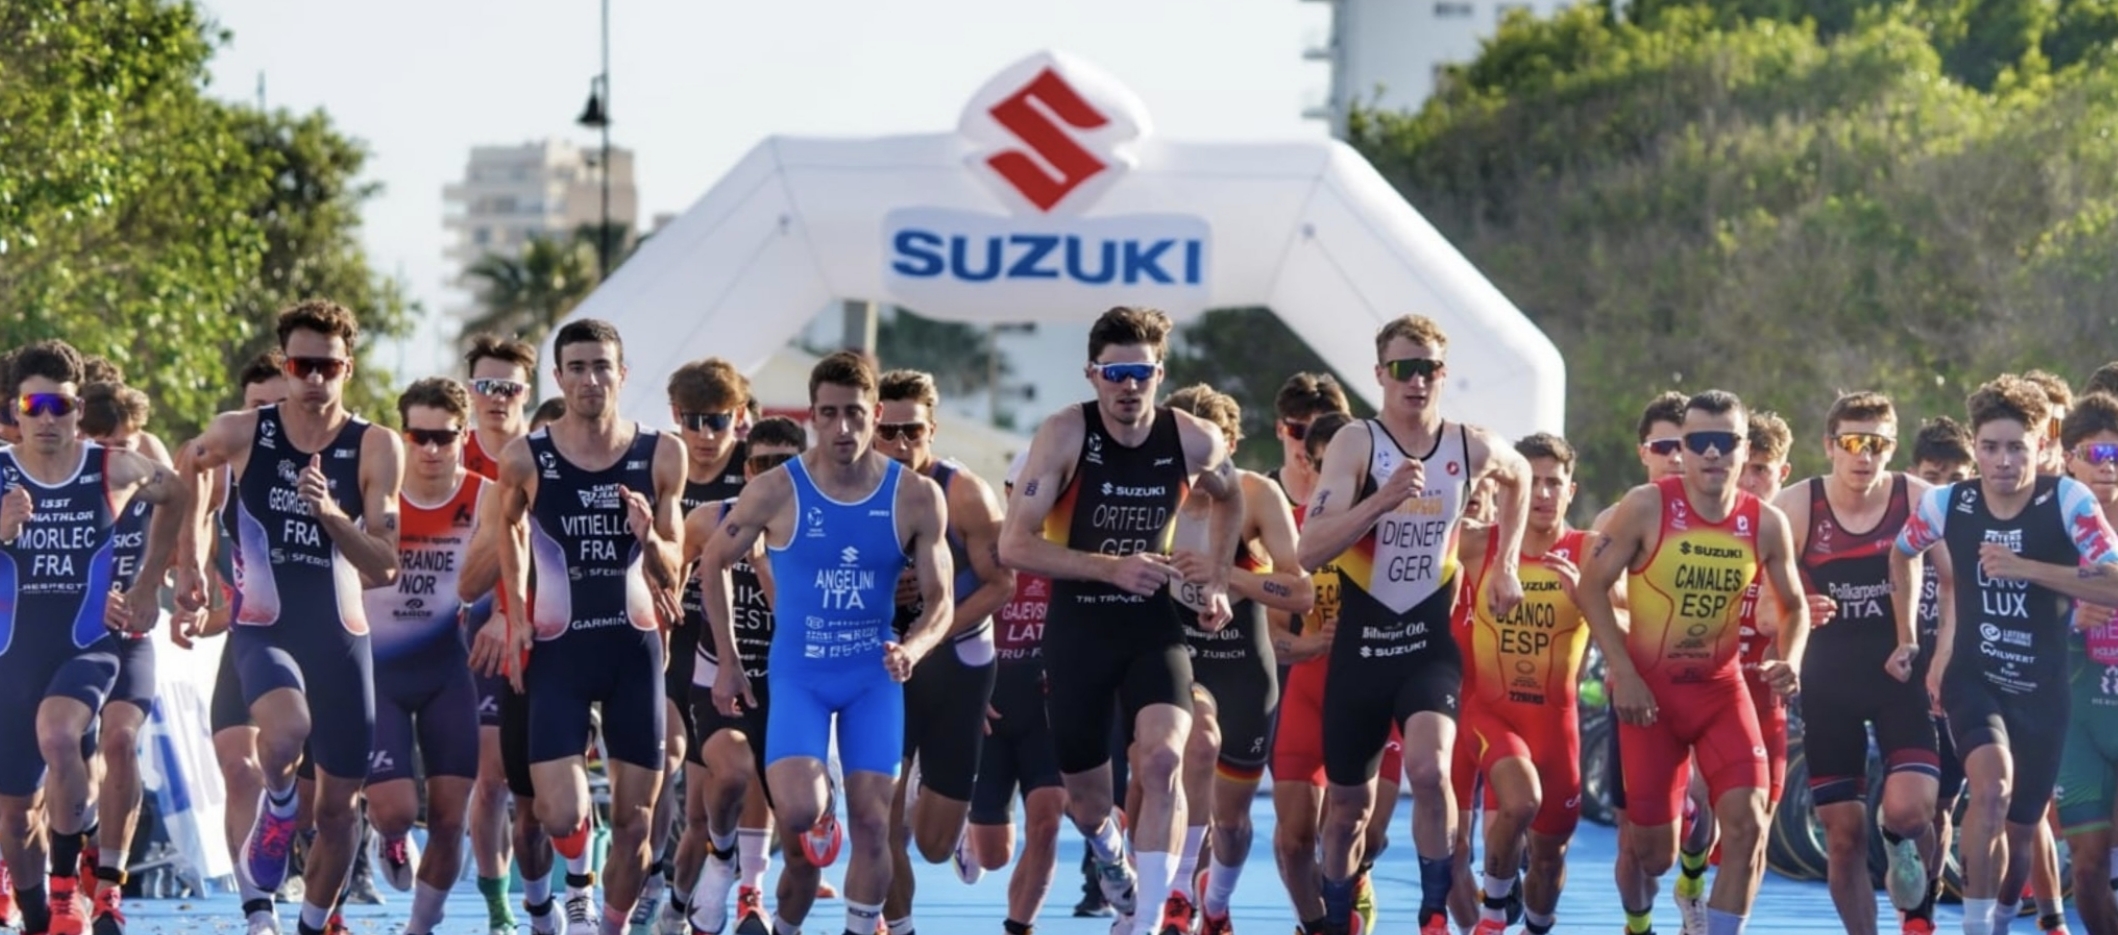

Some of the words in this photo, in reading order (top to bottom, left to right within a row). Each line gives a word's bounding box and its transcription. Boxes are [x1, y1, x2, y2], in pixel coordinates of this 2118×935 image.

[891, 229, 1202, 285] SUZUKI
[592, 483, 619, 492] SAINT
[1115, 486, 1166, 497] SUZUKI
[561, 514, 633, 537] VITIELLO
[1093, 504, 1166, 531] ORTFELD
[17, 526, 96, 550] MORLEC
[112, 532, 143, 548] SICS
[284, 519, 321, 548] FRA
[1382, 521, 1446, 548] DIENER
[399, 549, 455, 572] RANDE
[580, 540, 617, 561] FRA
[1694, 545, 1743, 559] SUZUKI
[32, 554, 75, 577] FRA
[1388, 554, 1433, 583] GER
[398, 573, 437, 595] NOR
[814, 568, 876, 591] ANGELINI
[1520, 581, 1563, 591] UZUKI
[1675, 563, 1742, 592] CANALES
[822, 588, 866, 611] ITA
[1075, 594, 1096, 604] TRI
[1098, 593, 1147, 604] TRAVEL
[1181, 582, 1207, 607] GE
[1680, 593, 1728, 619] ESP
[1981, 588, 2029, 618] LUX
[1003, 601, 1048, 621] GAJEVS
[1841, 599, 1884, 619] ITA
[1919, 602, 1939, 621] RA
[571, 615, 627, 631] GARMIN
[1202, 649, 1246, 659] ZURICH
[1375, 640, 1427, 657] SUZUKI
[1501, 629, 1549, 656] ESP
[1980, 640, 2036, 664] WILWERT
